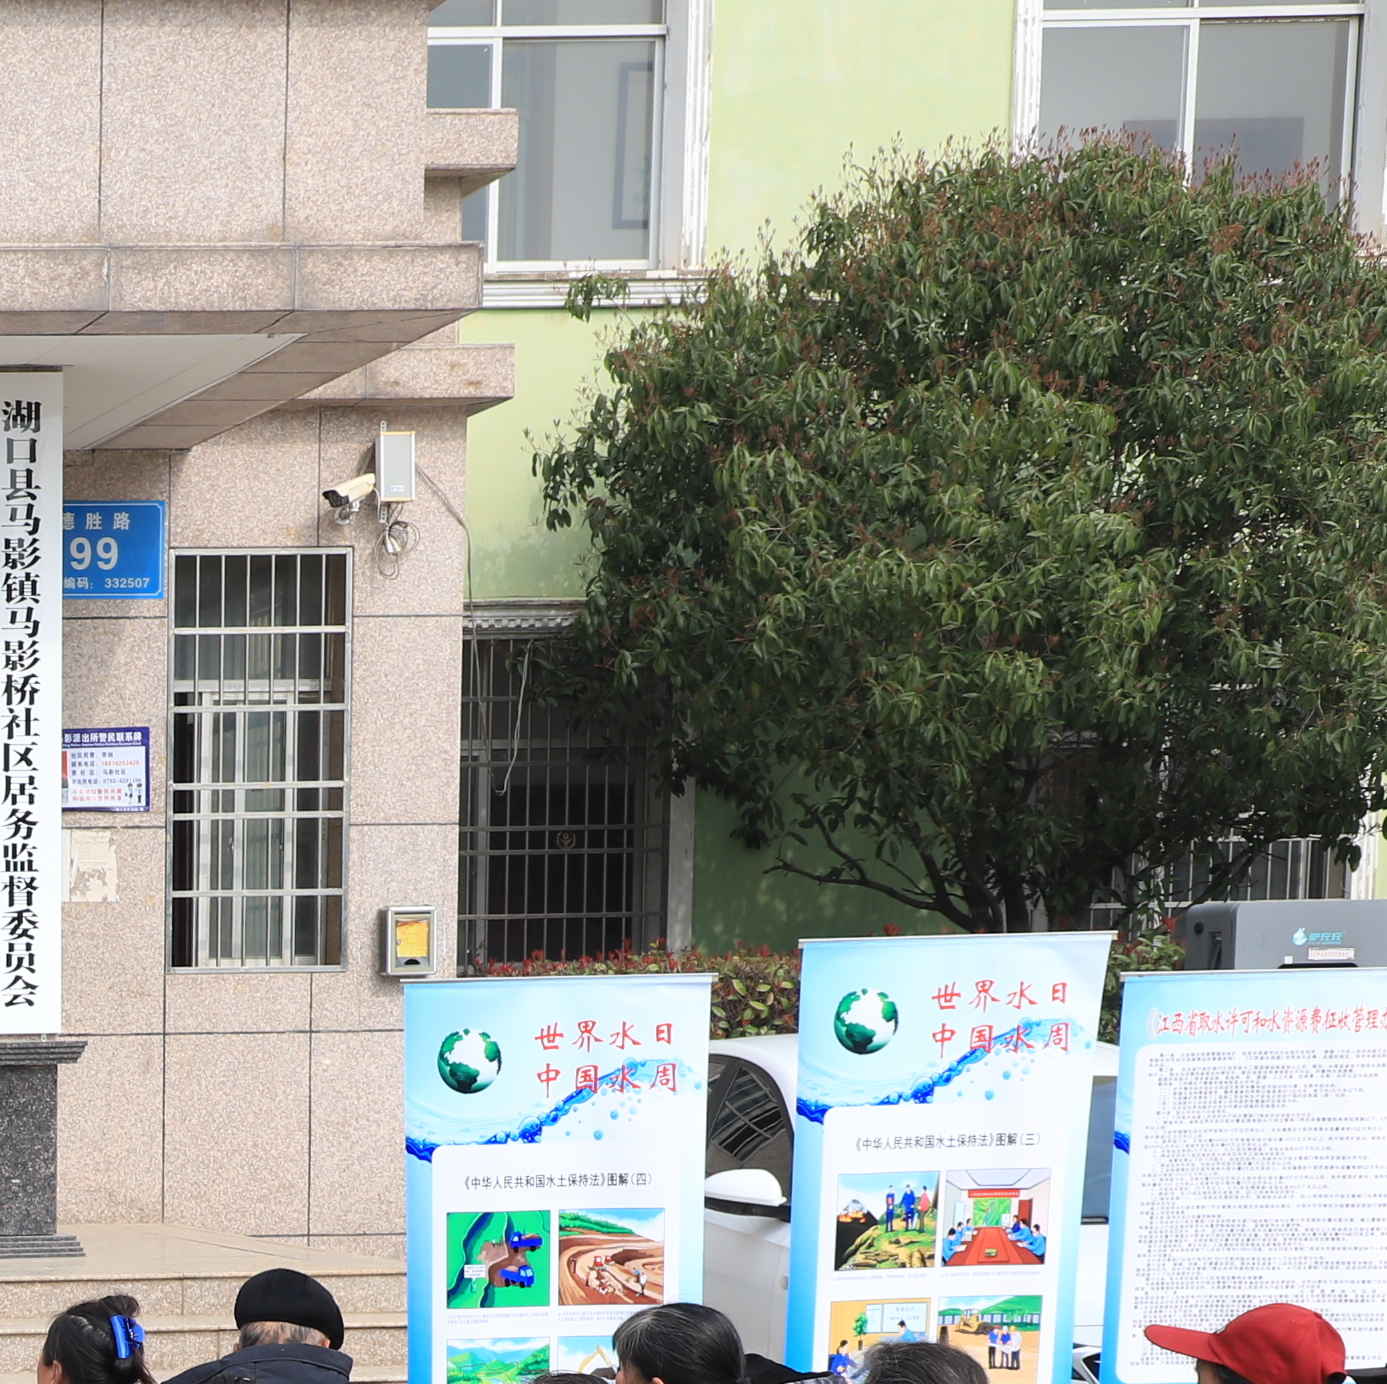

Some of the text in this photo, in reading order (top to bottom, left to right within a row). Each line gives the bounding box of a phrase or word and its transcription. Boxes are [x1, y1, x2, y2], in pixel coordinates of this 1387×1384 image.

[70, 536, 119, 571] 99
[104, 577, 151, 589] 332507
[0, 399, 42, 1008] 湖口县马影镇马影桥社区居务监督委员会
[931, 979, 1068, 1013] 世界水日
[534, 1019, 673, 1053] 世界水日
[931, 1022, 1070, 1059] 中国水周
[536, 1062, 677, 1098] 中国水周
